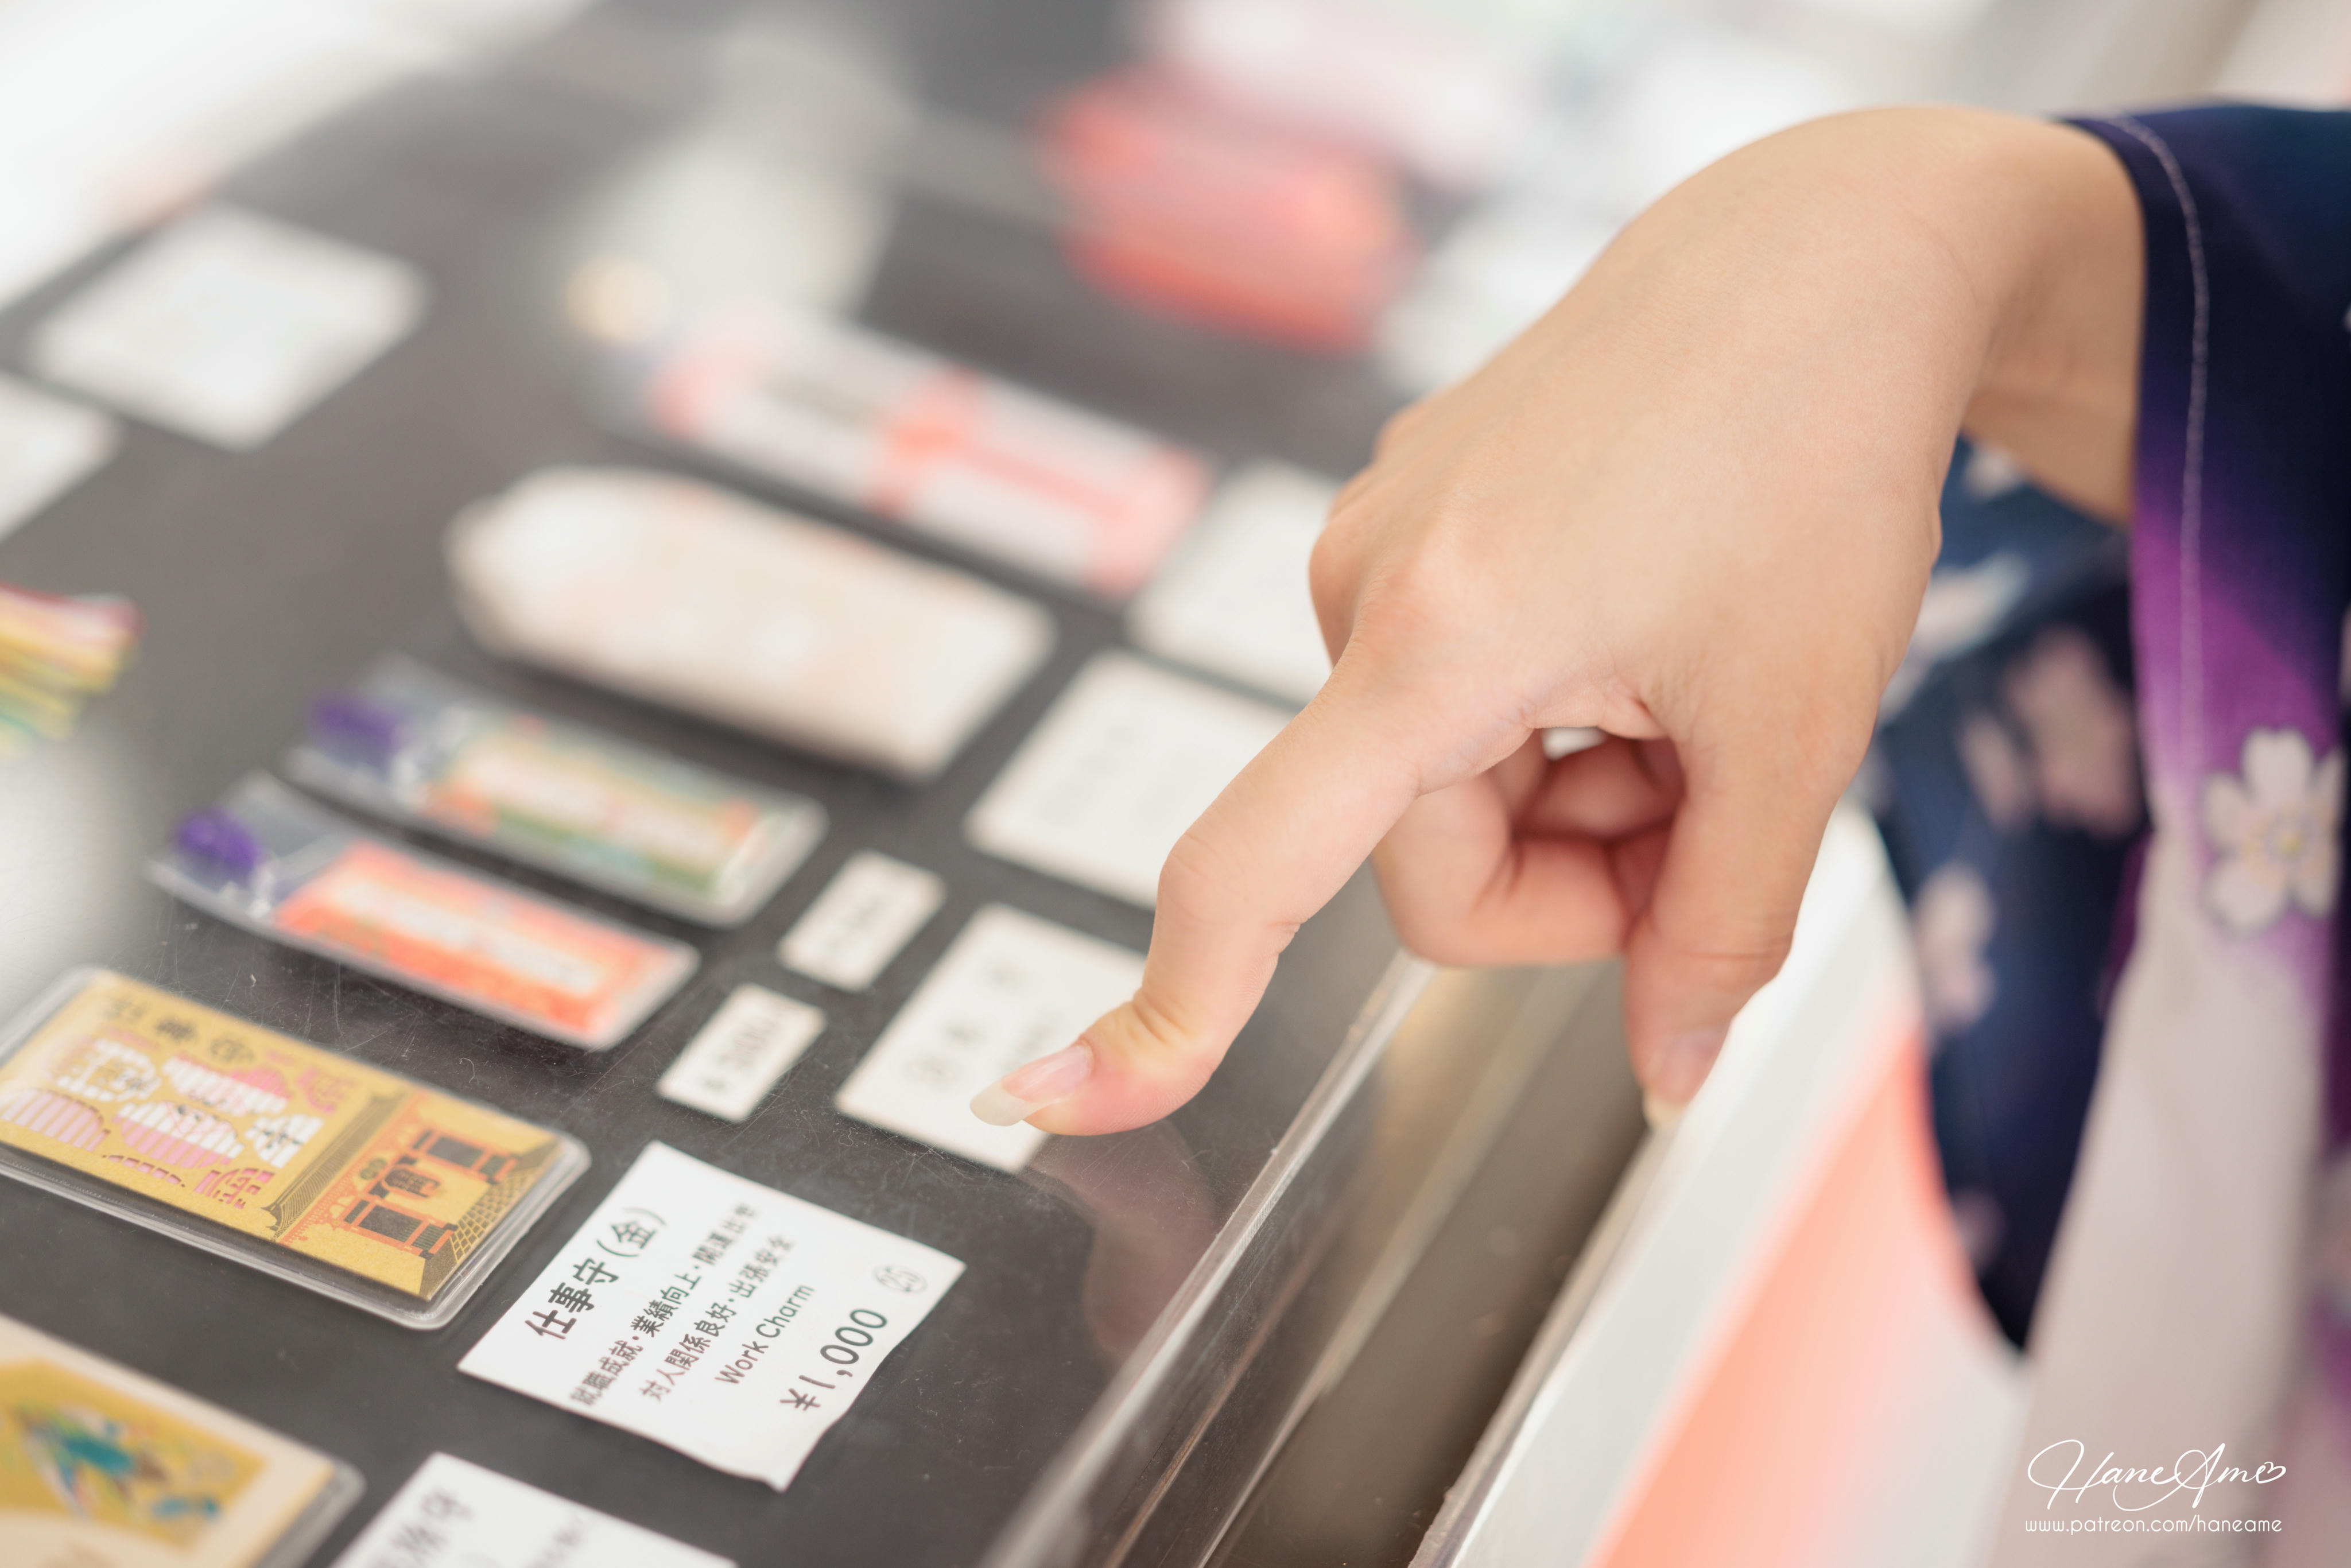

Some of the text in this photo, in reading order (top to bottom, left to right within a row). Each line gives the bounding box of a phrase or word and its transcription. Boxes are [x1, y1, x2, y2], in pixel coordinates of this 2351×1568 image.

[523, 1206, 666, 1340] 仕事守（金）
[713, 1283, 815, 1385] Work Charm
[779, 1307, 889, 1412] ¥1,000
